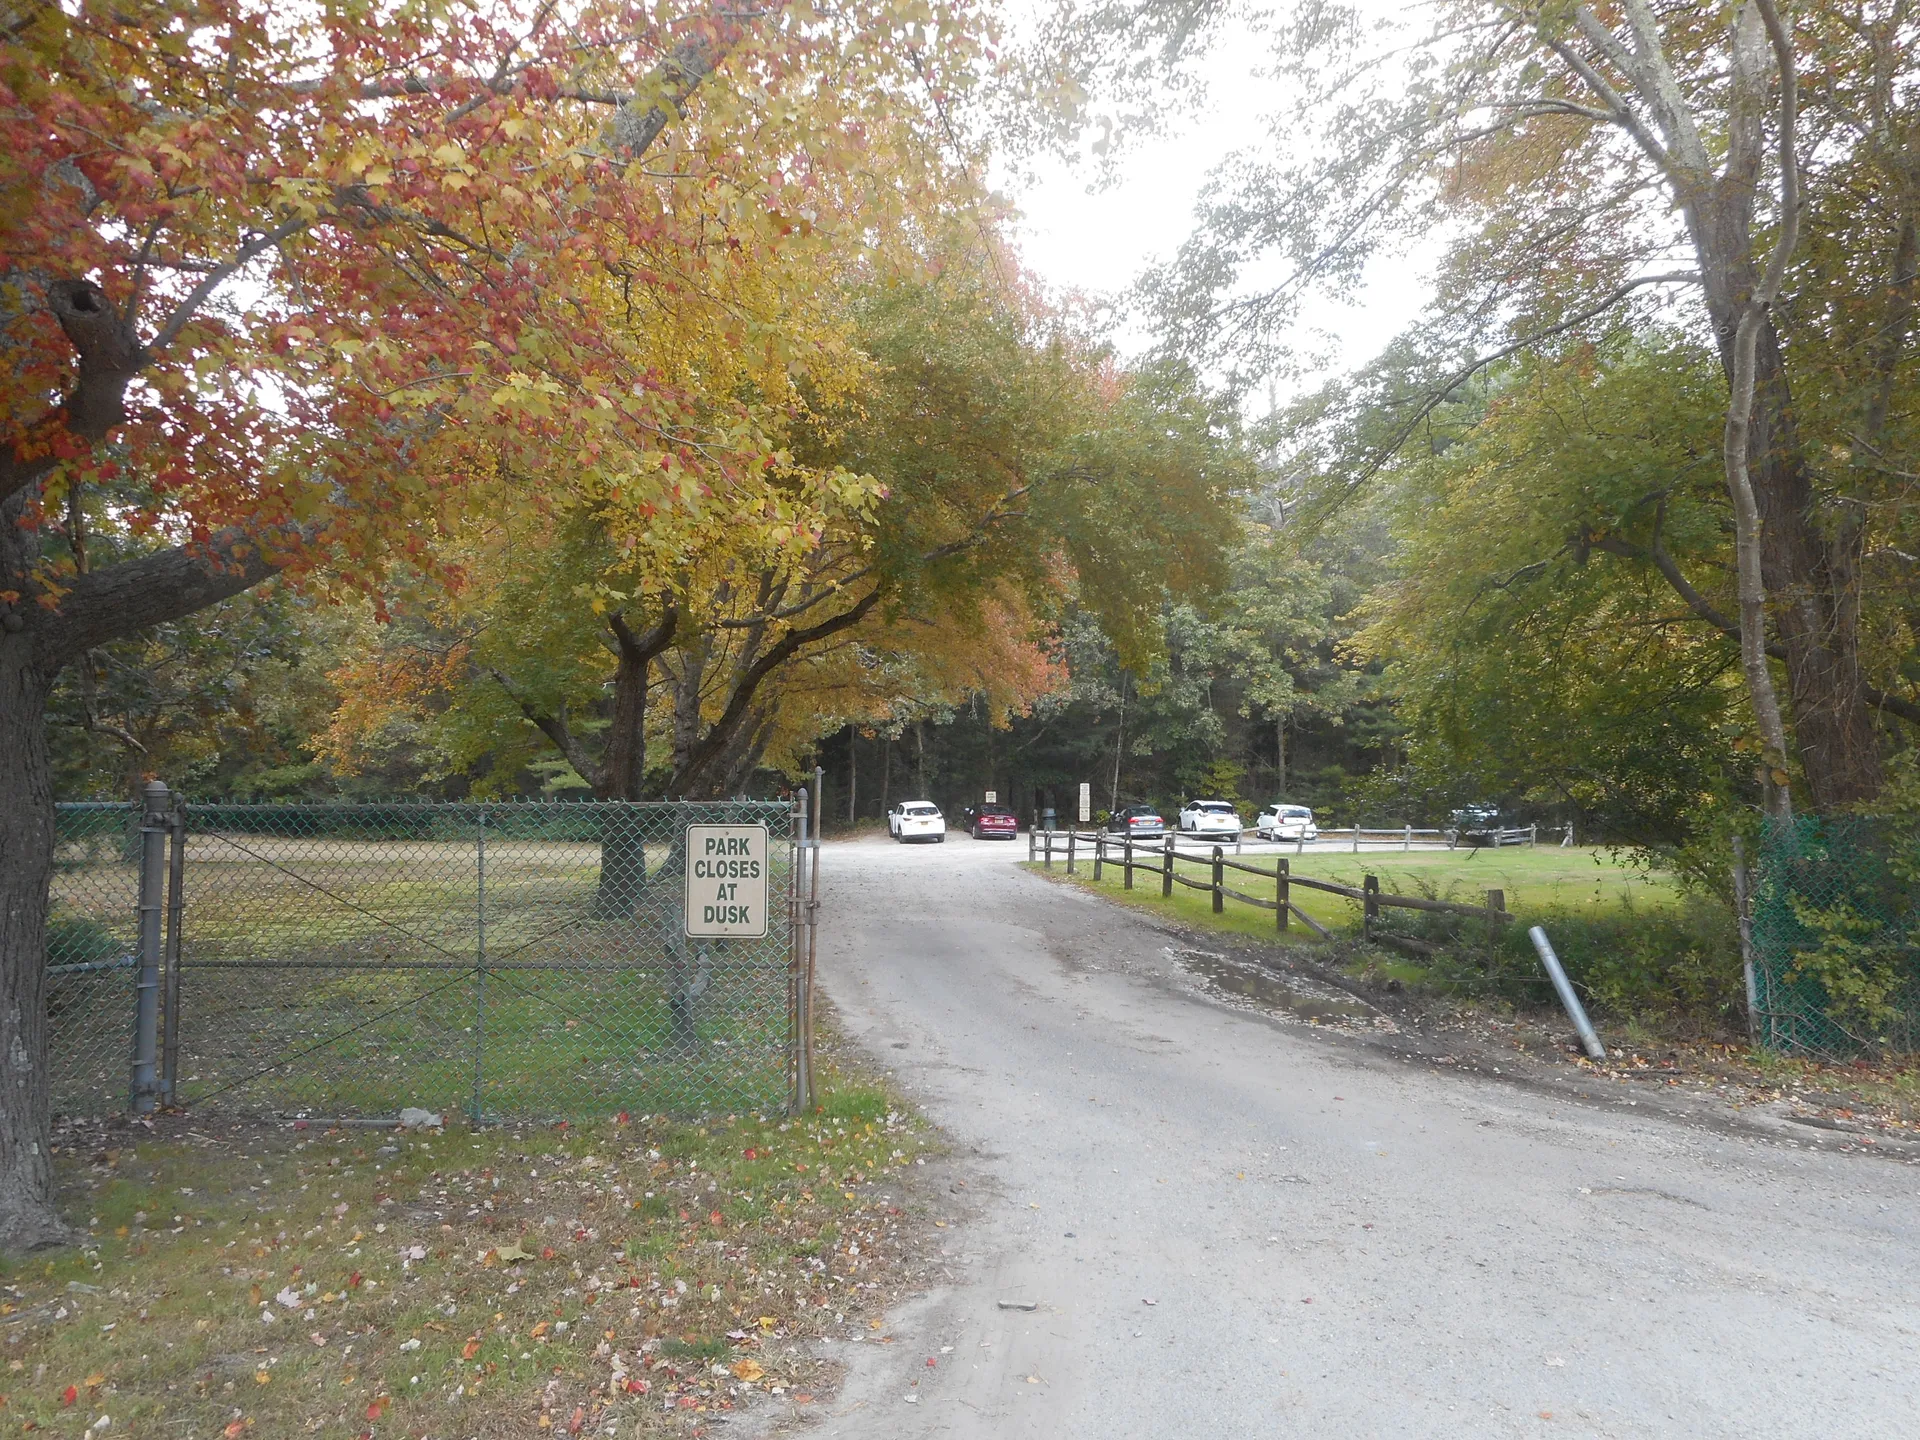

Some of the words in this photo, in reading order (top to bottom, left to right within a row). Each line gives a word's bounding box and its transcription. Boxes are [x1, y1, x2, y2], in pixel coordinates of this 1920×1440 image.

[705, 838, 750, 856] PARK
[694, 860, 760, 879] CLOSES
[716, 883, 738, 901] AT
[703, 905, 750, 924] DUSK
